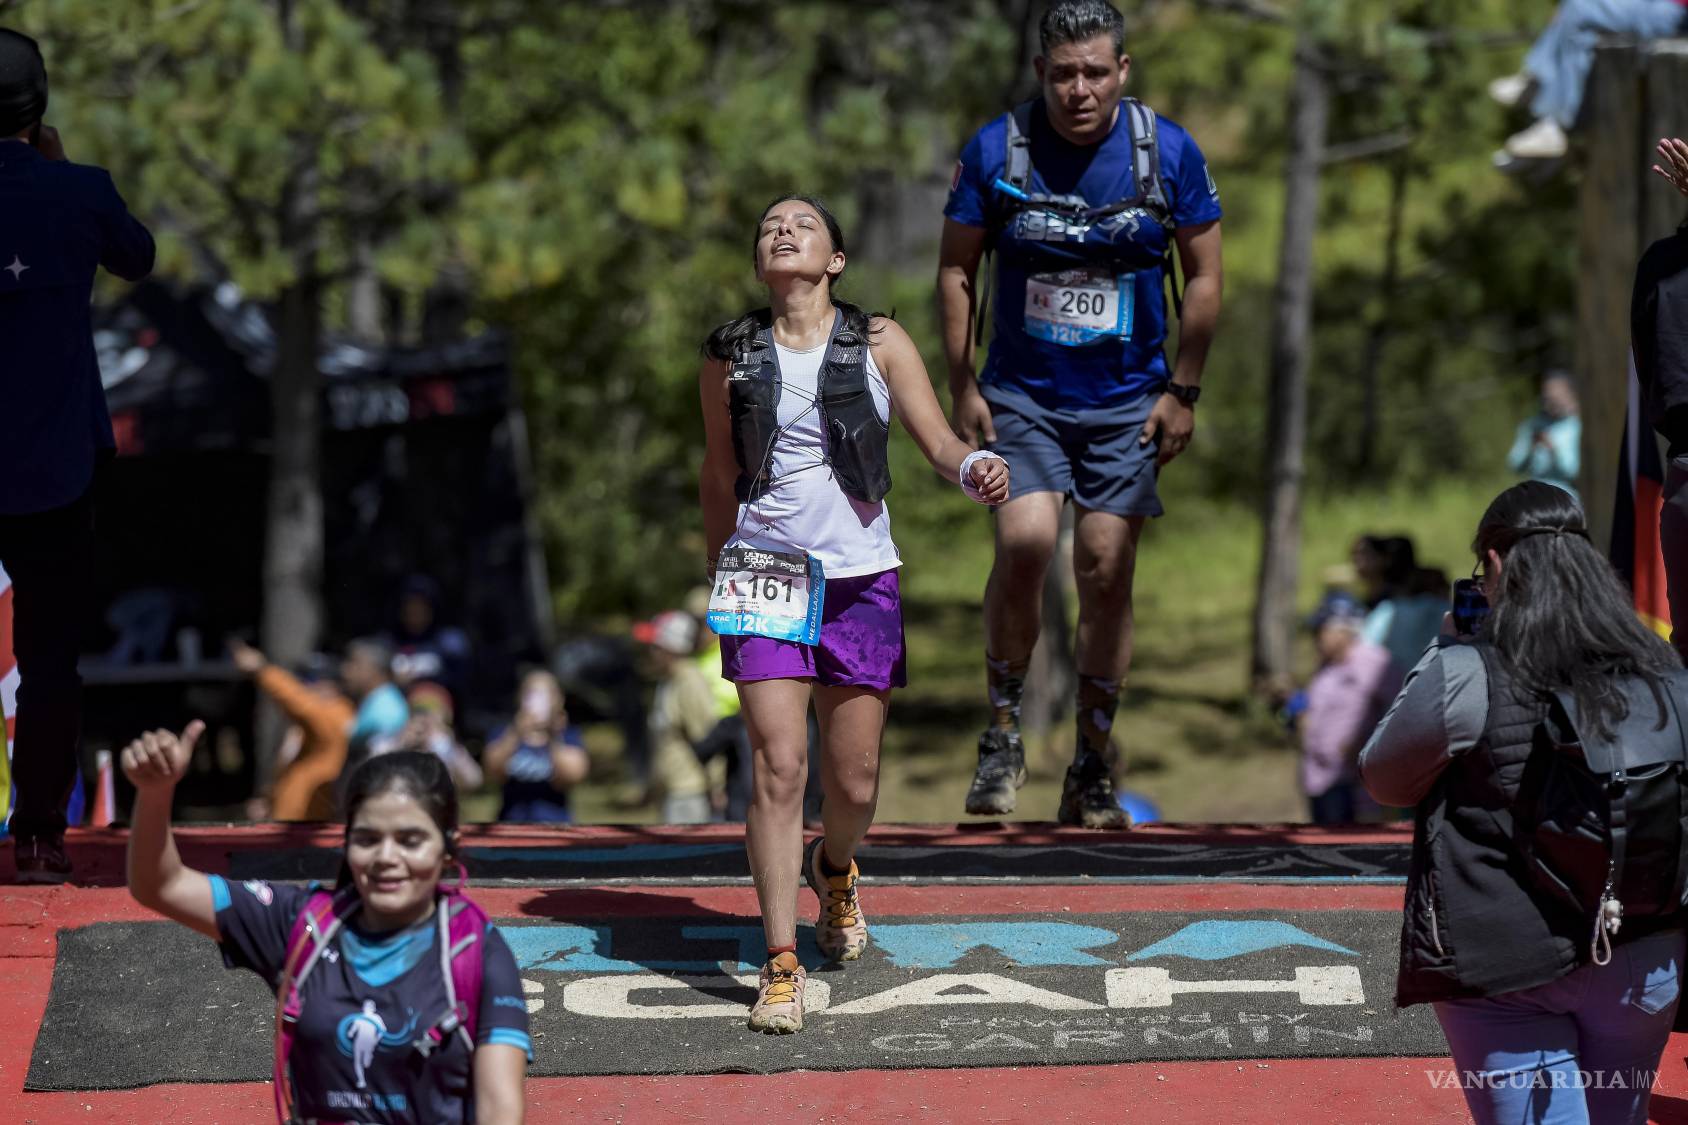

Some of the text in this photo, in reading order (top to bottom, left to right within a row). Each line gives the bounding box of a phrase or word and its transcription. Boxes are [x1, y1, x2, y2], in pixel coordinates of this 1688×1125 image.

[1060, 290, 1105, 316] 260
[1050, 323, 1082, 343] 12K
[748, 574, 793, 603] 161
[736, 614, 769, 632] 12K
[520, 964, 1366, 1020] OAH
[1238, 1011, 1310, 1025] by
[870, 1025, 1374, 1052] GARMIN
